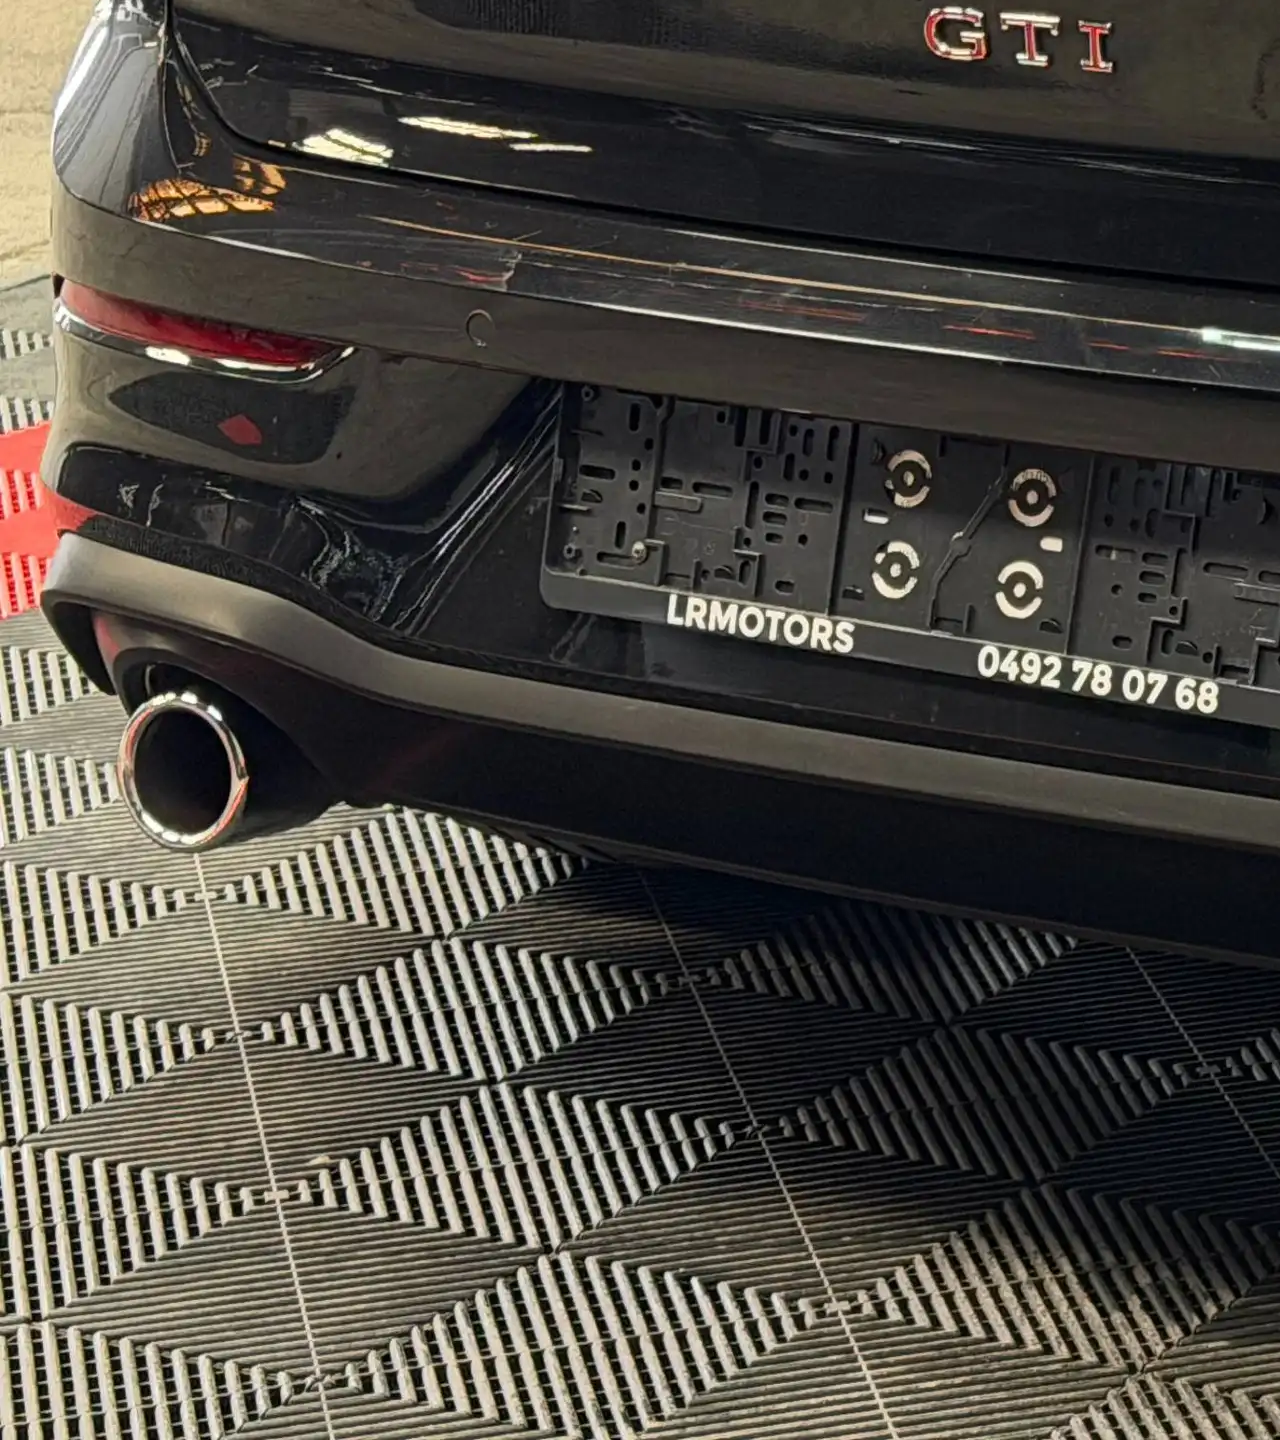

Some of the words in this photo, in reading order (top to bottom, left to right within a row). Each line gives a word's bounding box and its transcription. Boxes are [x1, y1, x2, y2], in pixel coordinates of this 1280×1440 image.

[923, 6, 1114, 73] GTI
[667, 594, 856, 654] LRMOTORS
[977, 645, 1062, 689] 0492
[1071, 660, 1113, 696] 78
[1122, 669, 1169, 704] 07
[1175, 677, 1219, 714] 68
